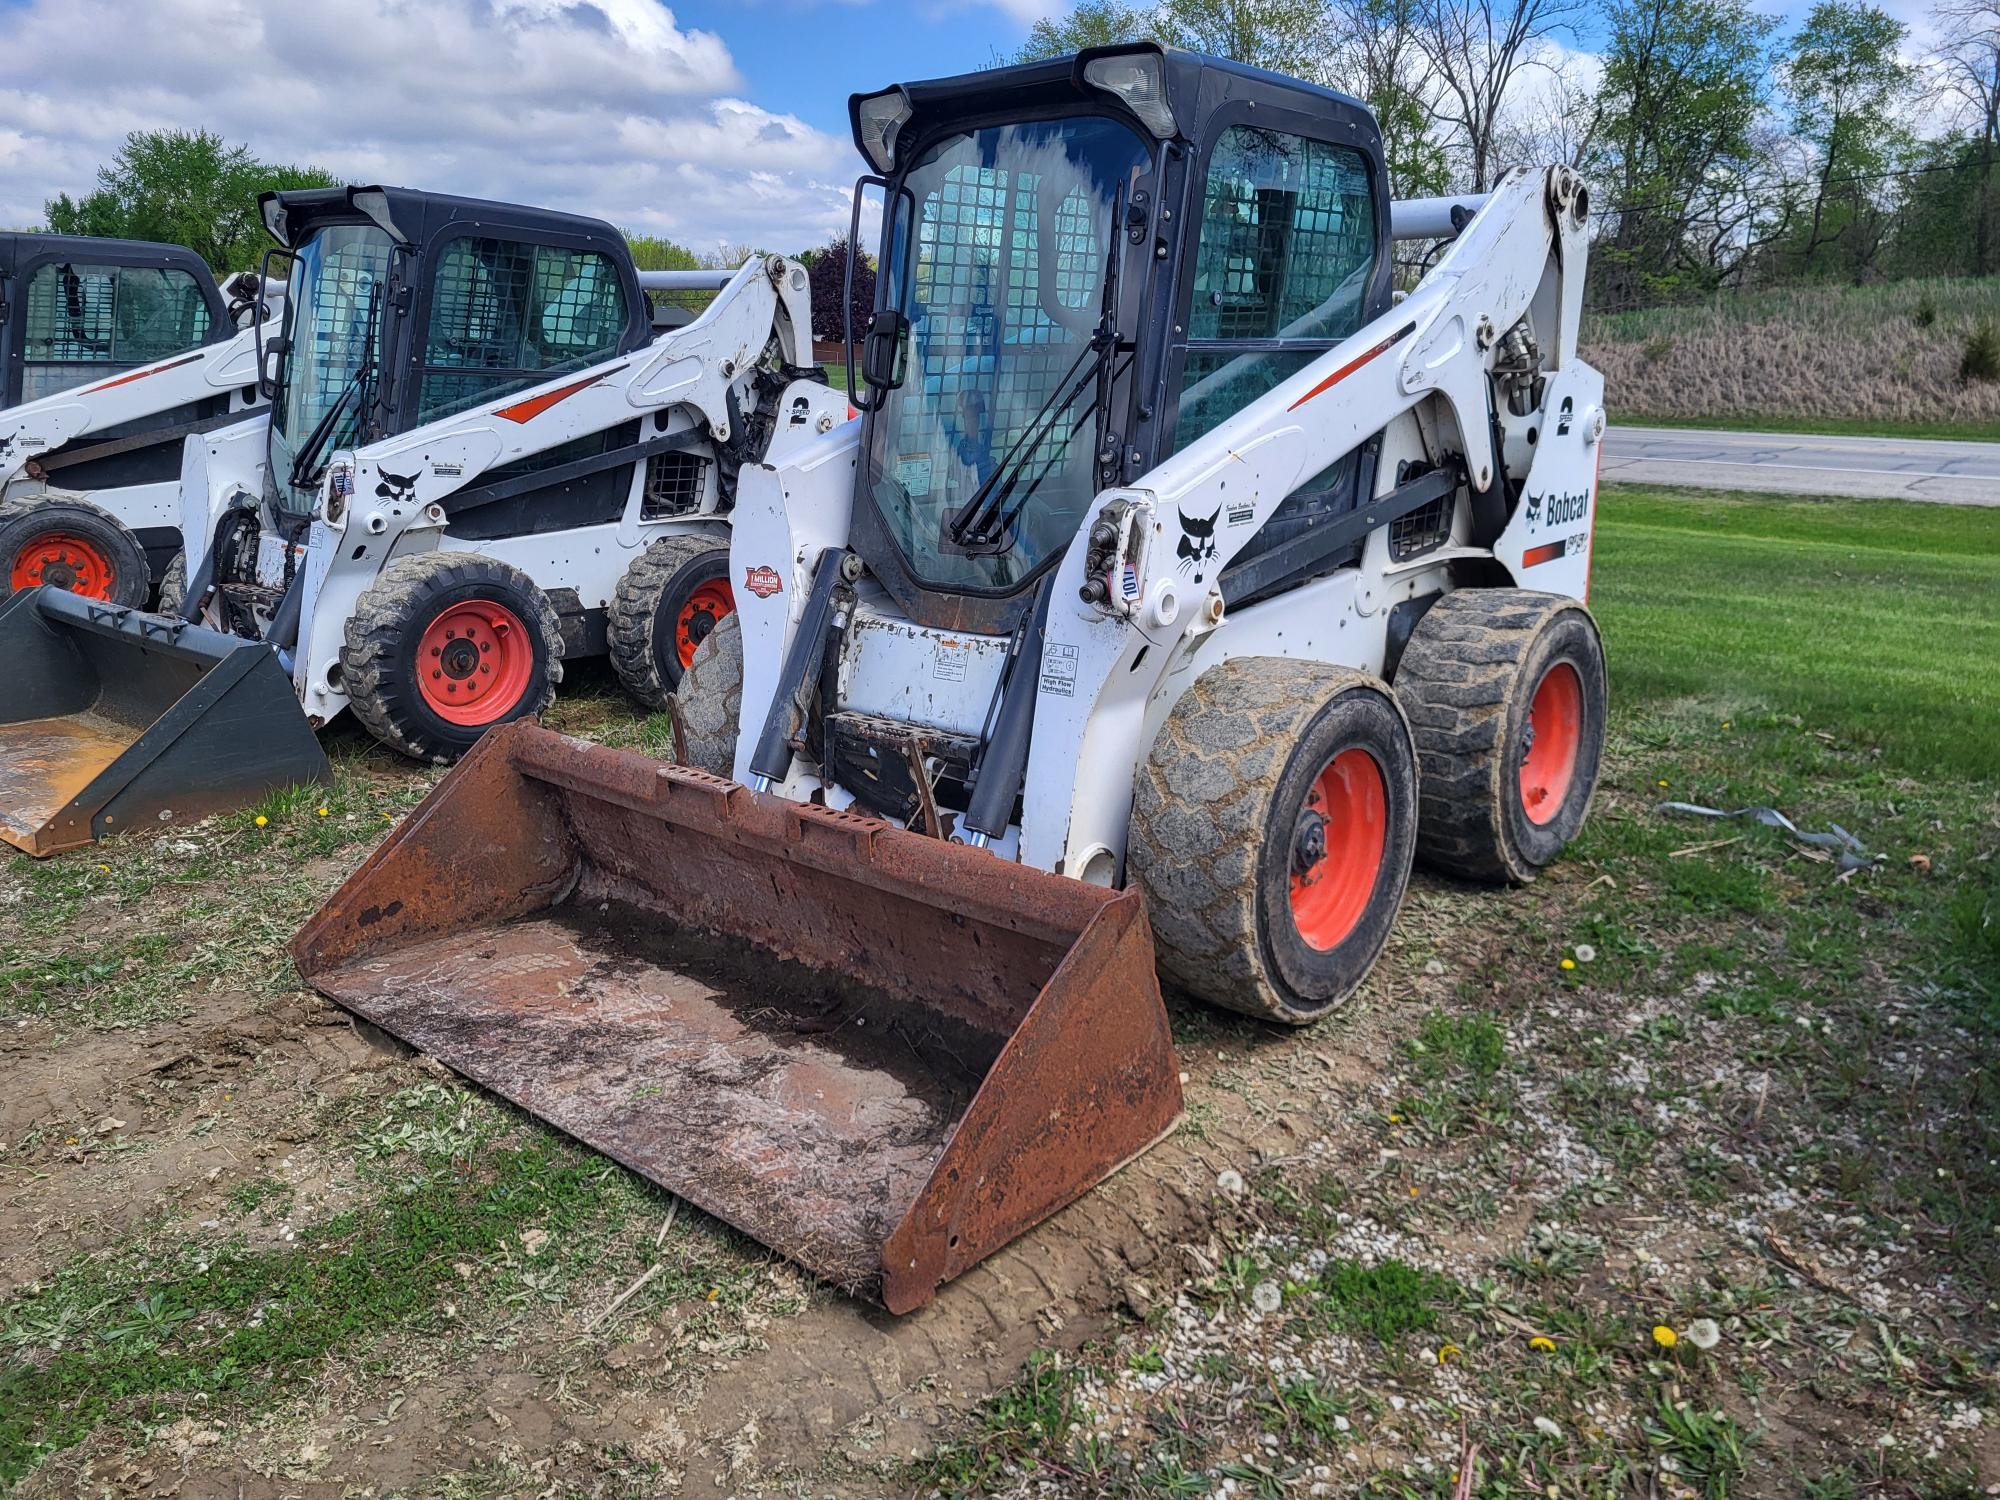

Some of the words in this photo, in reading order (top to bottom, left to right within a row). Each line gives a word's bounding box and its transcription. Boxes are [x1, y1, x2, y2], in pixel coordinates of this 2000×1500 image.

[790, 396, 809, 424] 2
[1557, 396, 1573, 436] 2
[1546, 488, 1589, 527] Bobcat
[754, 575, 778, 584] MILLION
[1042, 684, 1072, 695] Hydraulics
[1043, 677, 1057, 687] High
[1058, 680, 1072, 688] Flow
